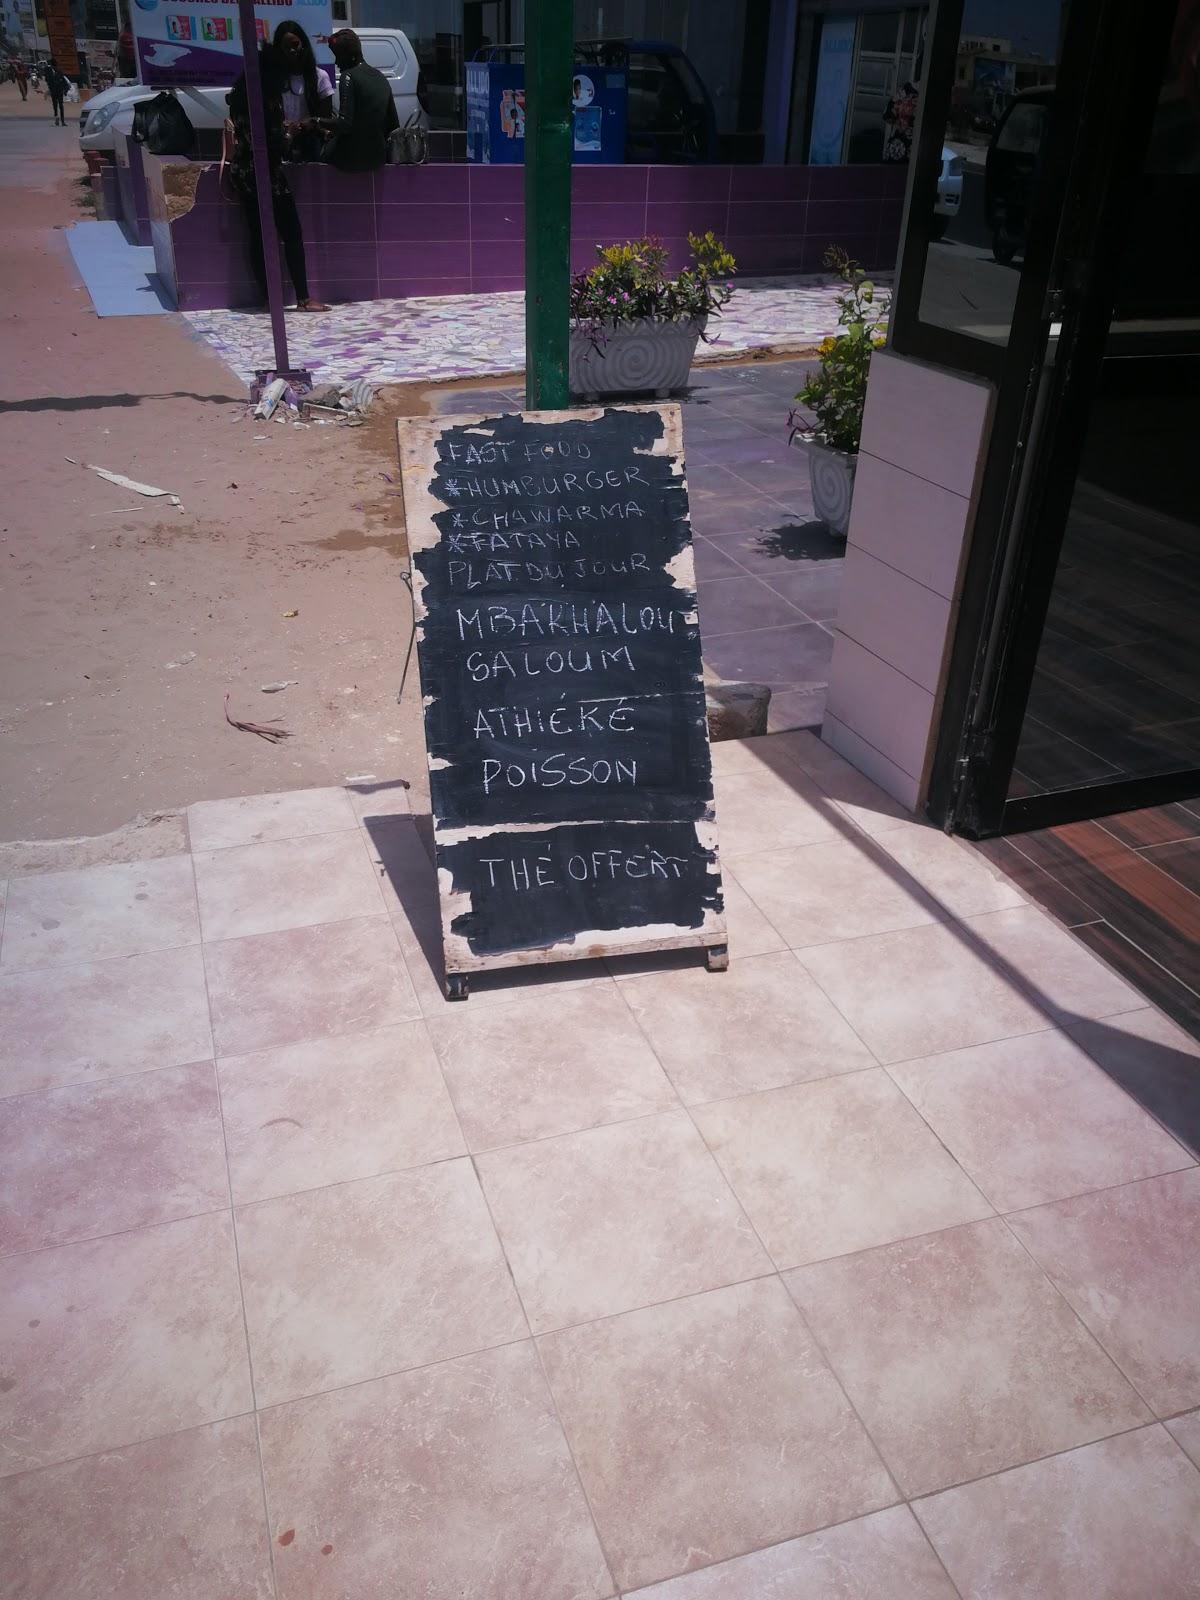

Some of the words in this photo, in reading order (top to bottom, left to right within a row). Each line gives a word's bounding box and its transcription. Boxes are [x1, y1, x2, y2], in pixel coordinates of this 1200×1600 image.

[449, 440, 515, 464] FAST
[523, 440, 591, 461] FOOD
[574, 553, 651, 578] JOUR
[466, 646, 636, 682] SALOUM
[482, 753, 637, 794] POISSON
[568, 849, 688, 883] OFFERT
